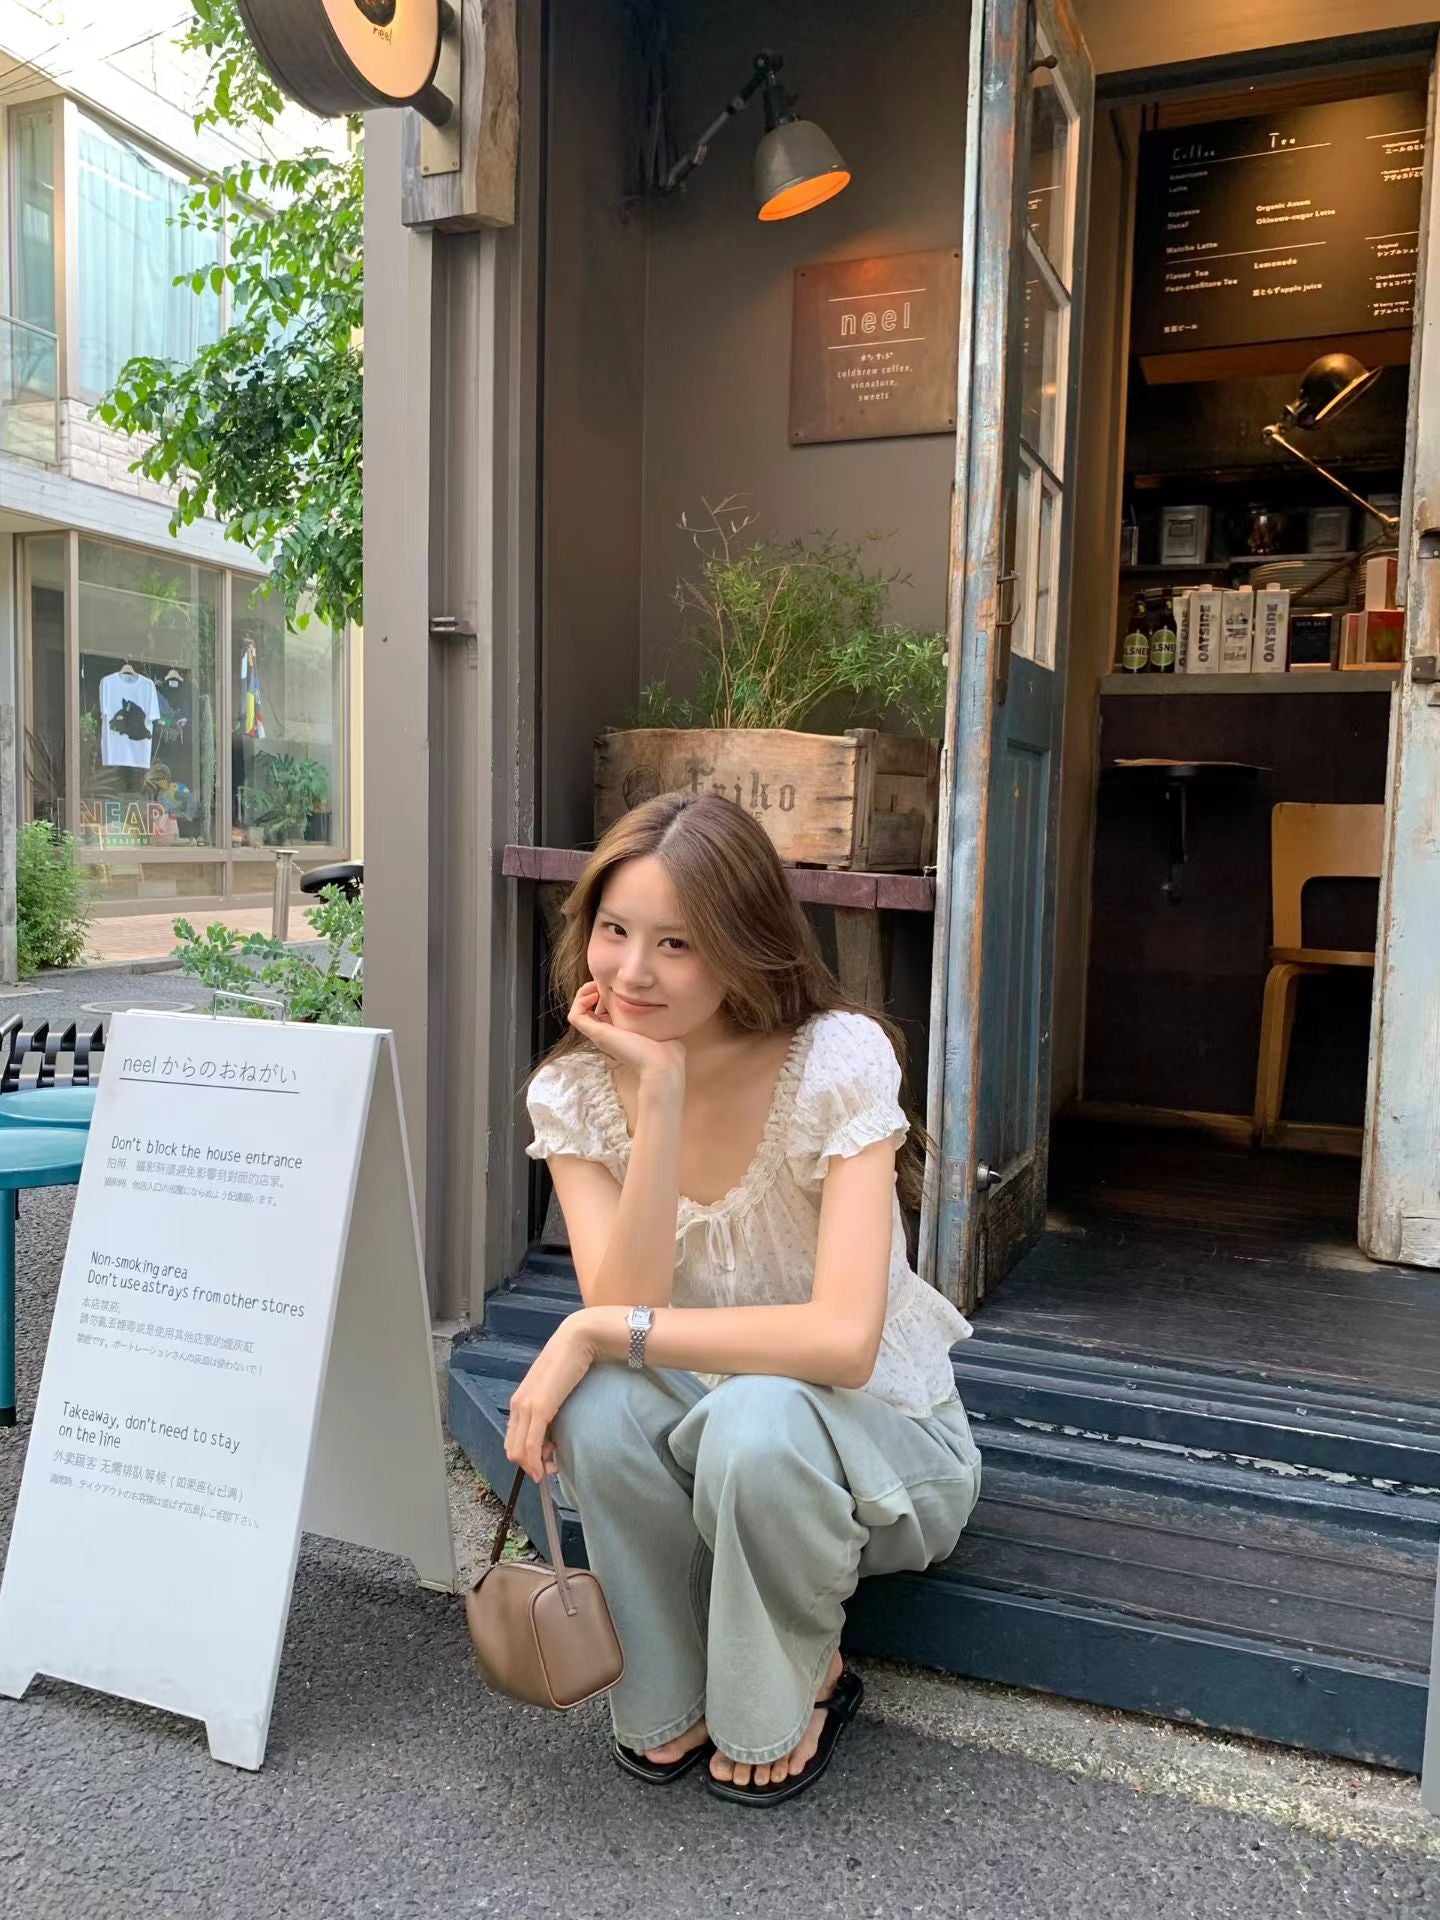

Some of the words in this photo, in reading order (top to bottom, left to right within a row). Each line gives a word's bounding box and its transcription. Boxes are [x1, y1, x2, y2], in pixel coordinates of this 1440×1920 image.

[1268, 132, 1296, 149] Tea
[1256, 203, 1286, 213] Organic
[1253, 257, 1298, 270] Lemonade
[841, 302, 911, 336] neel
[837, 367, 878, 379] coldbrew
[858, 392, 889, 402] sweets
[1197, 604, 1211, 663] OATSIDE
[1263, 603, 1278, 663] OATSIDE
[123, 1055, 157, 1074] neel
[161, 1056, 297, 1084] からのおねがい
[111, 1135, 142, 1152] Don't
[146, 1139, 178, 1157] block
[181, 1143, 201, 1159] the
[206, 1146, 241, 1163] house
[245, 1150, 303, 1169] entrance
[90, 1250, 160, 1279] Non-smoking
[161, 1264, 188, 1280] area
[87, 1269, 118, 1288] Don't
[120, 1276, 140, 1291] use
[142, 1281, 189, 1302] astrays
[192, 1286, 221, 1304] from
[222, 1291, 259, 1310] other
[261, 1299, 305, 1318] stores
[58, 1424, 73, 1438] on
[76, 1427, 96, 1445] the
[99, 1430, 121, 1449] line
[63, 1401, 119, 1430] Takeaway,
[125, 1414, 157, 1434] don't
[159, 1421, 189, 1441] need
[193, 1427, 207, 1444] to
[210, 1433, 240, 1455] stay
